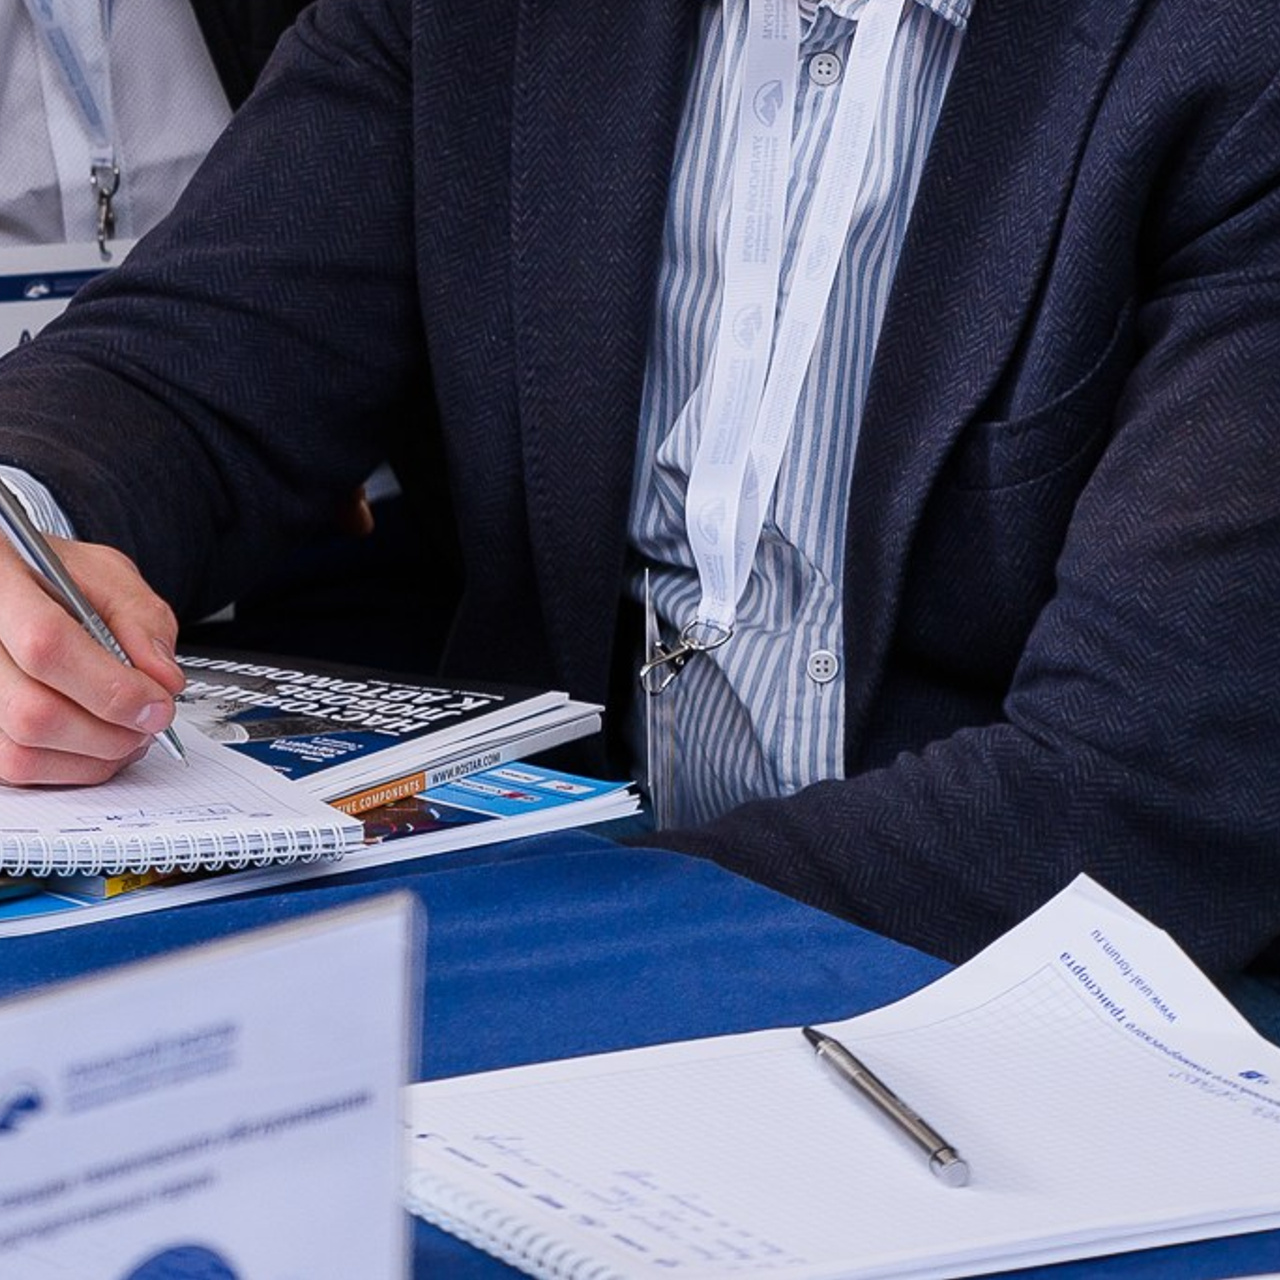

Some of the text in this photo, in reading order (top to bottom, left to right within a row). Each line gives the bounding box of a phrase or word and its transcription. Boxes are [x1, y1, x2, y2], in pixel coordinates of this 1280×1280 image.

[276, 683, 462, 721] ЛЮБОВЬ
[447, 696, 491, 710] К
[359, 780, 420, 805] COMPONENTS
[1059, 950, 1126, 1023] транспорта
[1090, 929, 1178, 1023] www.ural-forum.ru
